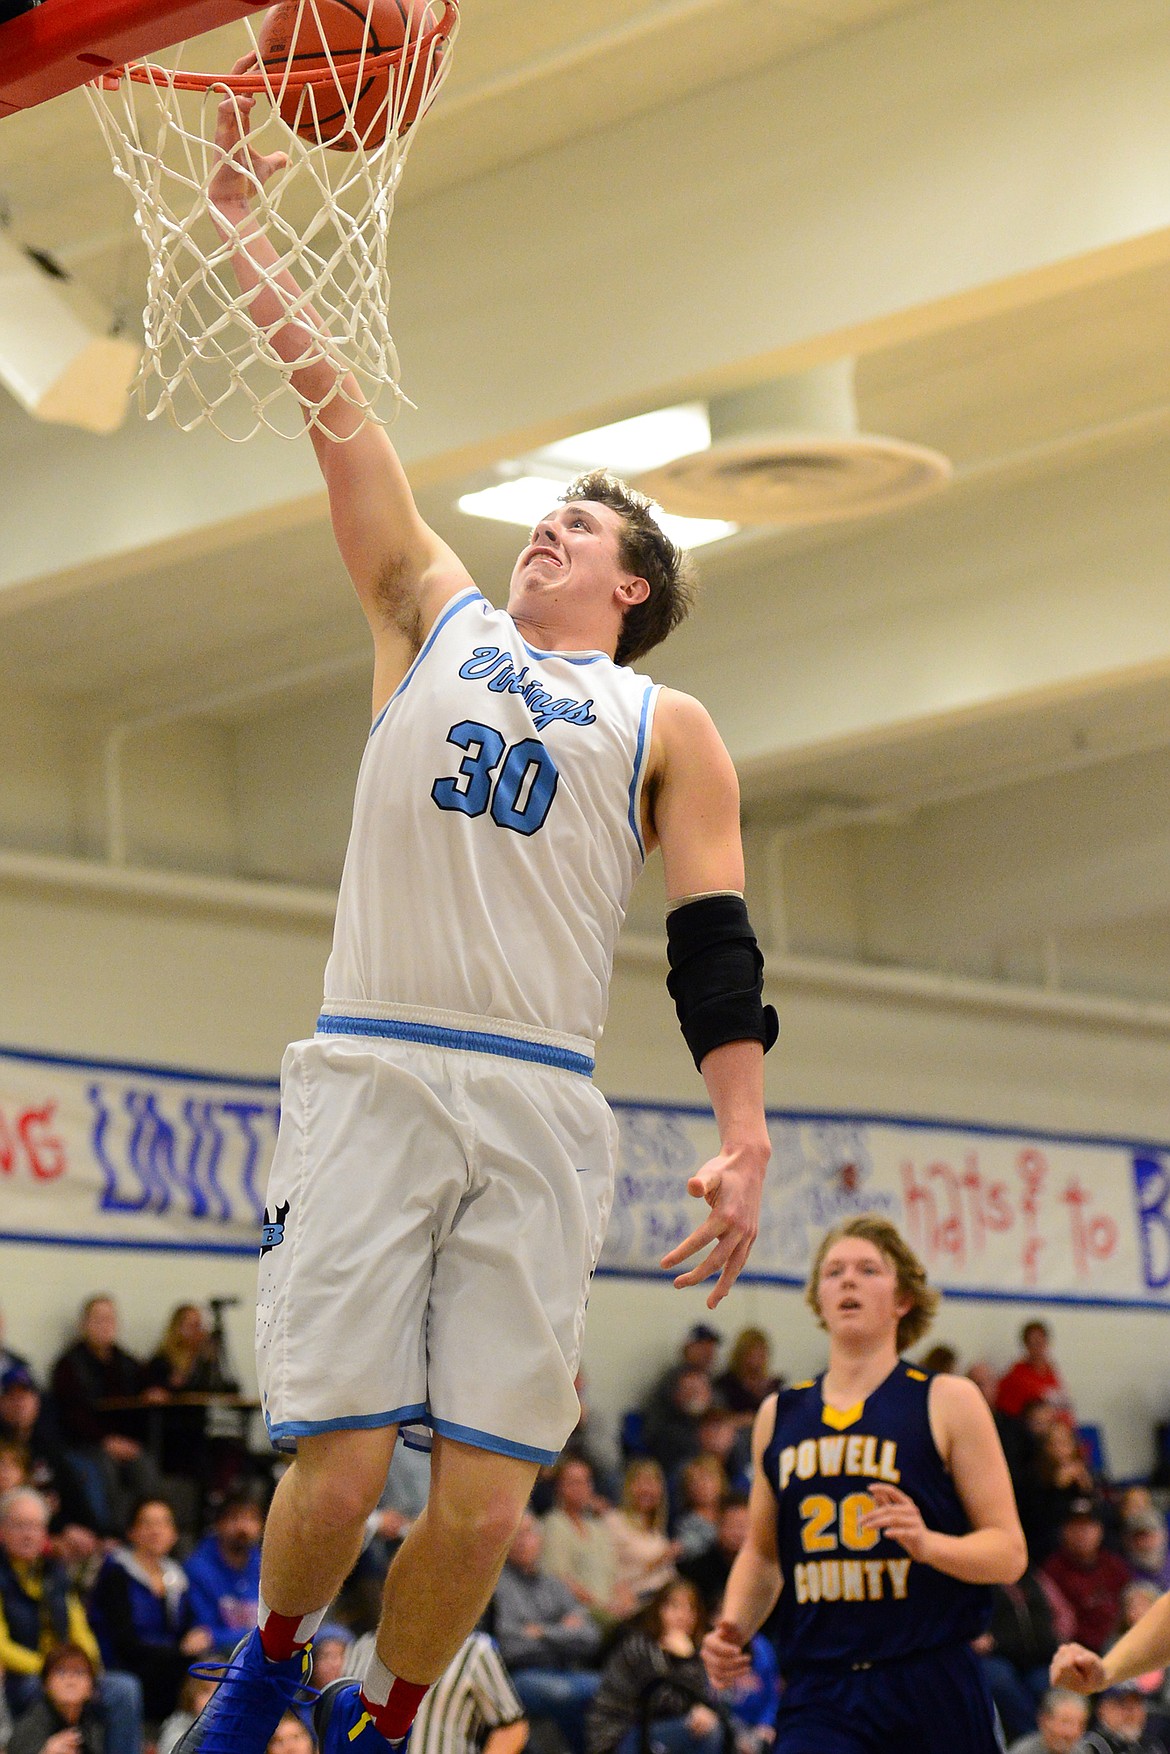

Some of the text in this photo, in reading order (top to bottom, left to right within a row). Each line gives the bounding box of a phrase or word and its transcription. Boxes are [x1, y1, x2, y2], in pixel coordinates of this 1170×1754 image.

[459, 646, 597, 732] Vikings
[430, 719, 560, 837] 30
[779, 1434, 901, 1491] POWELL
[799, 1491, 881, 1553] 20
[794, 1557, 912, 1605] COUNTY
